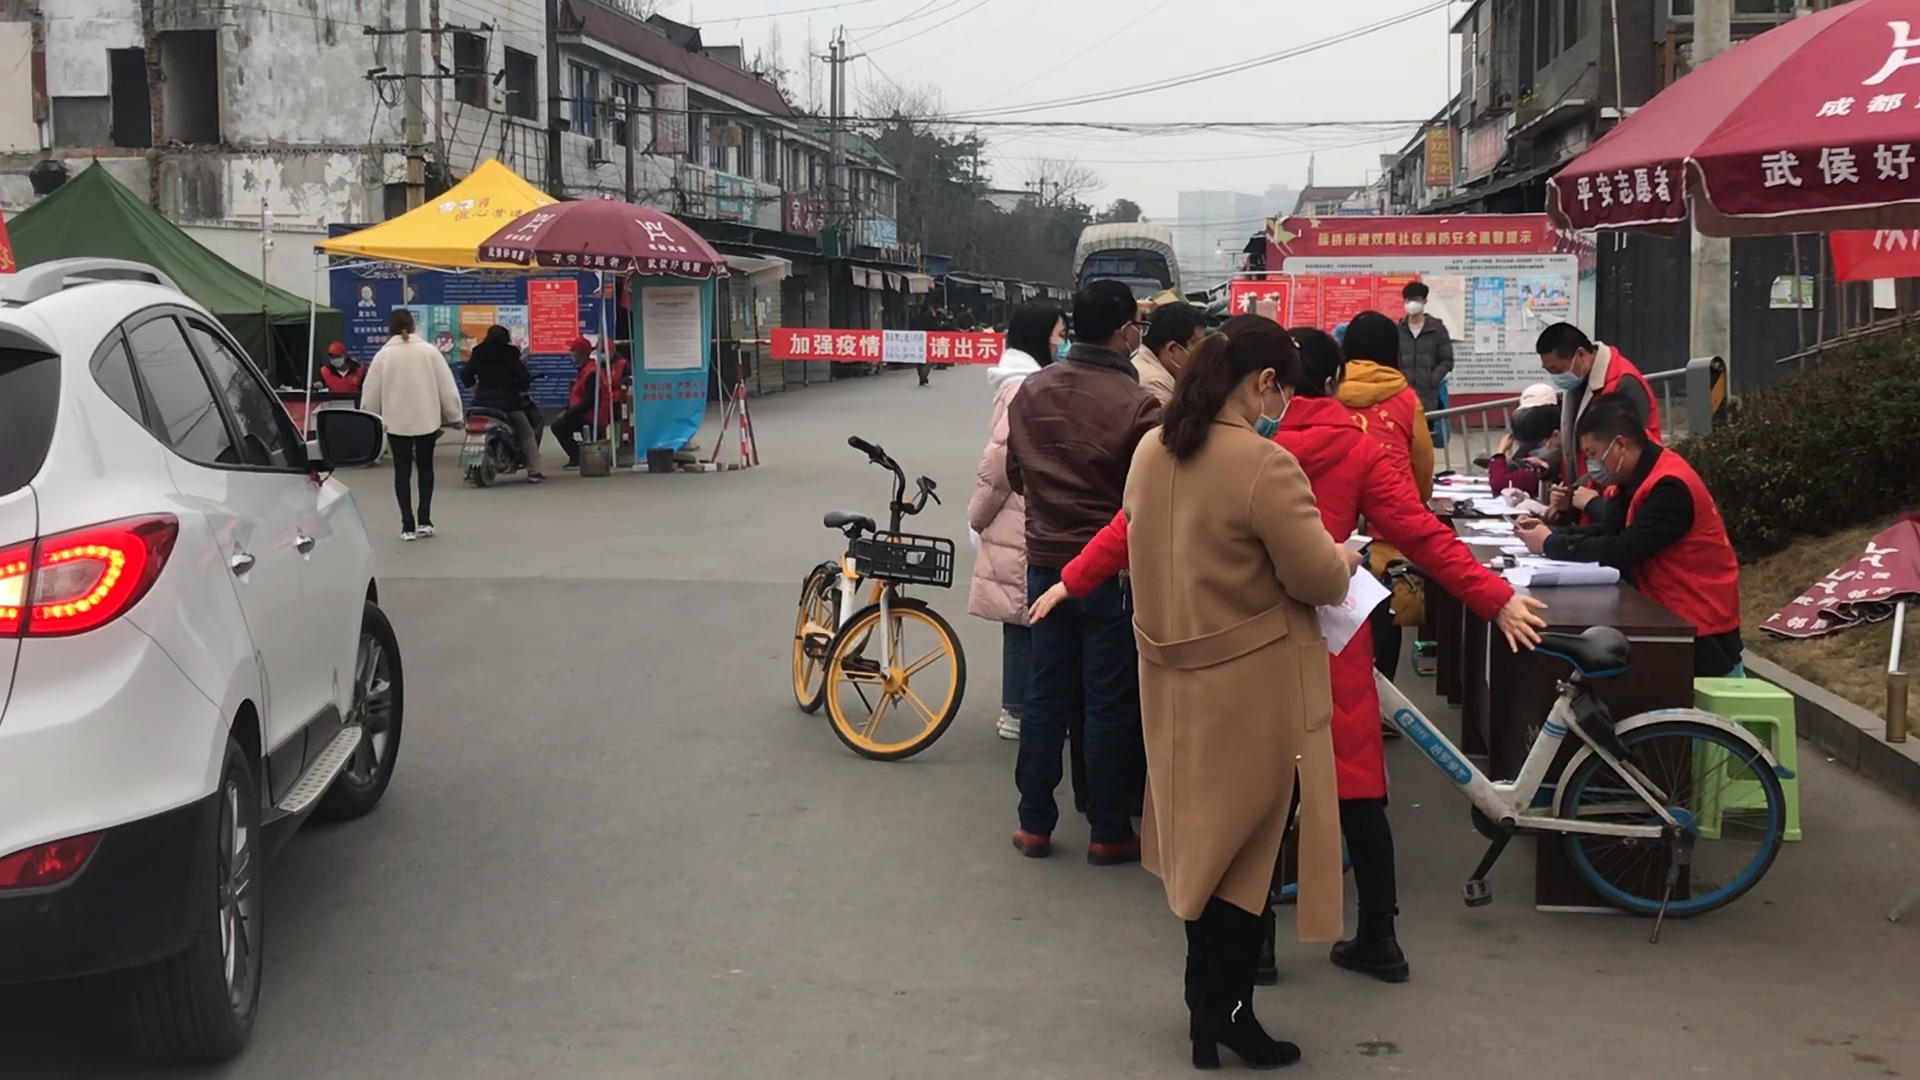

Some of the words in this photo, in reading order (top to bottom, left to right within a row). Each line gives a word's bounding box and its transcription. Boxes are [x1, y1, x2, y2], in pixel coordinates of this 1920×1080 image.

[1761, 144, 1917, 188] 武侯好
[1577, 166, 1671, 211] 平安志愿者
[789, 333, 881, 357] 加强疫情
[929, 336, 1005, 360] 请出示
